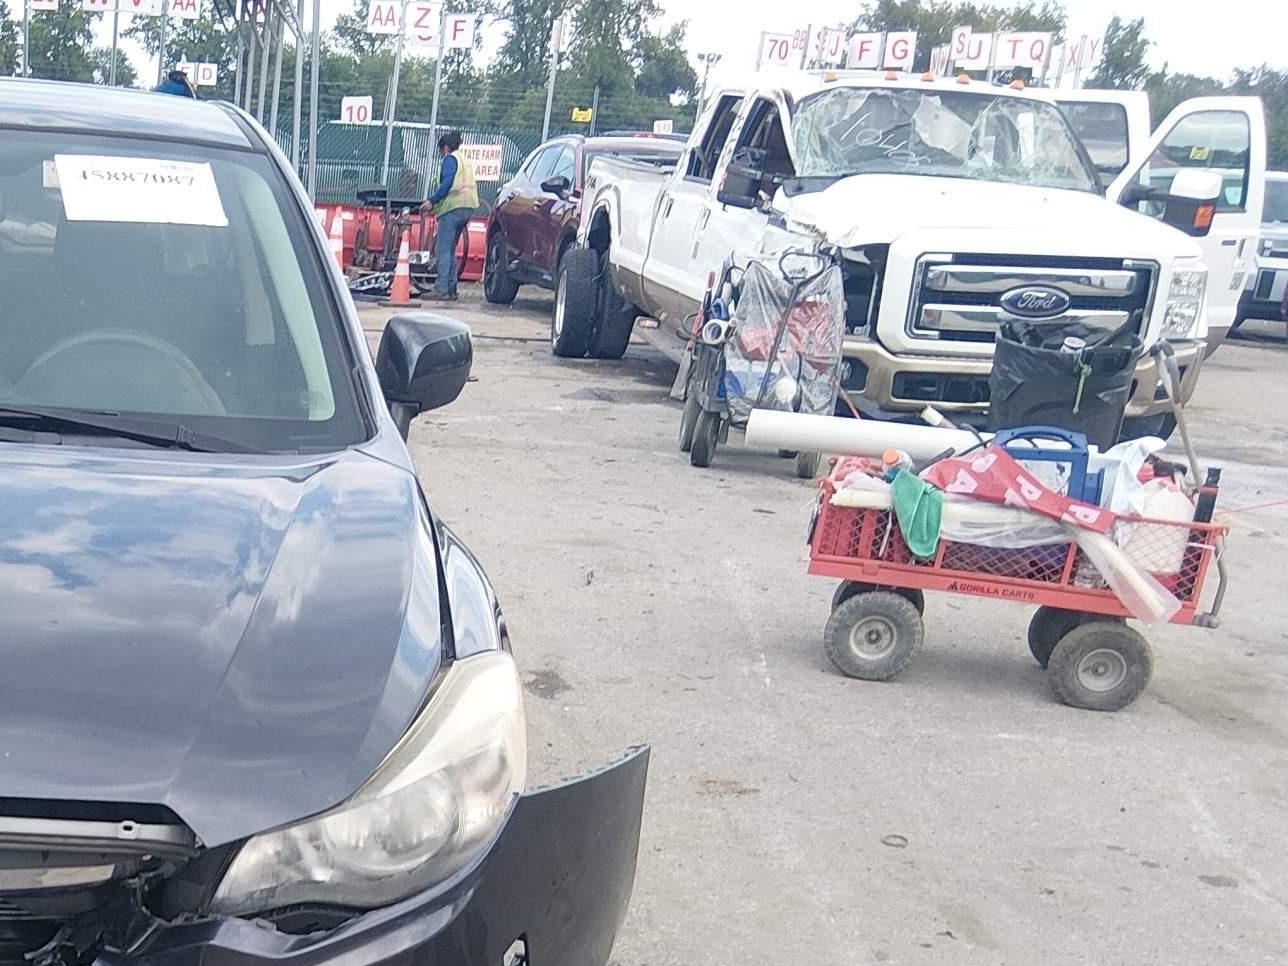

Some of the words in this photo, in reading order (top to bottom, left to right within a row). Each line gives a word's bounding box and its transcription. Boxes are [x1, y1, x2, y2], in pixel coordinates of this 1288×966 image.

[371, 5, 396, 26] AA
[414, 7, 432, 29] Z
[452, 19, 467, 41] F
[768, 38, 790, 61] 70
[830, 35, 840, 56] J
[857, 40, 873, 62] F
[891, 39, 909, 60] G
[957, 32, 967, 54] S
[966, 39, 982, 60] U
[1007, 39, 1023, 59] T
[1029, 39, 1045, 63] Q
[1067, 44, 1079, 66] X
[202, 67, 212, 81] D
[345, 105, 368, 122] 10
[462, 149, 481, 160] TATE
[482, 149, 501, 161] FARM
[475, 165, 499, 176] AREA
[1017, 291, 1057, 309] Ford
[959, 583, 999, 595] GORILLA
[1002, 590, 1035, 599] CARTS
